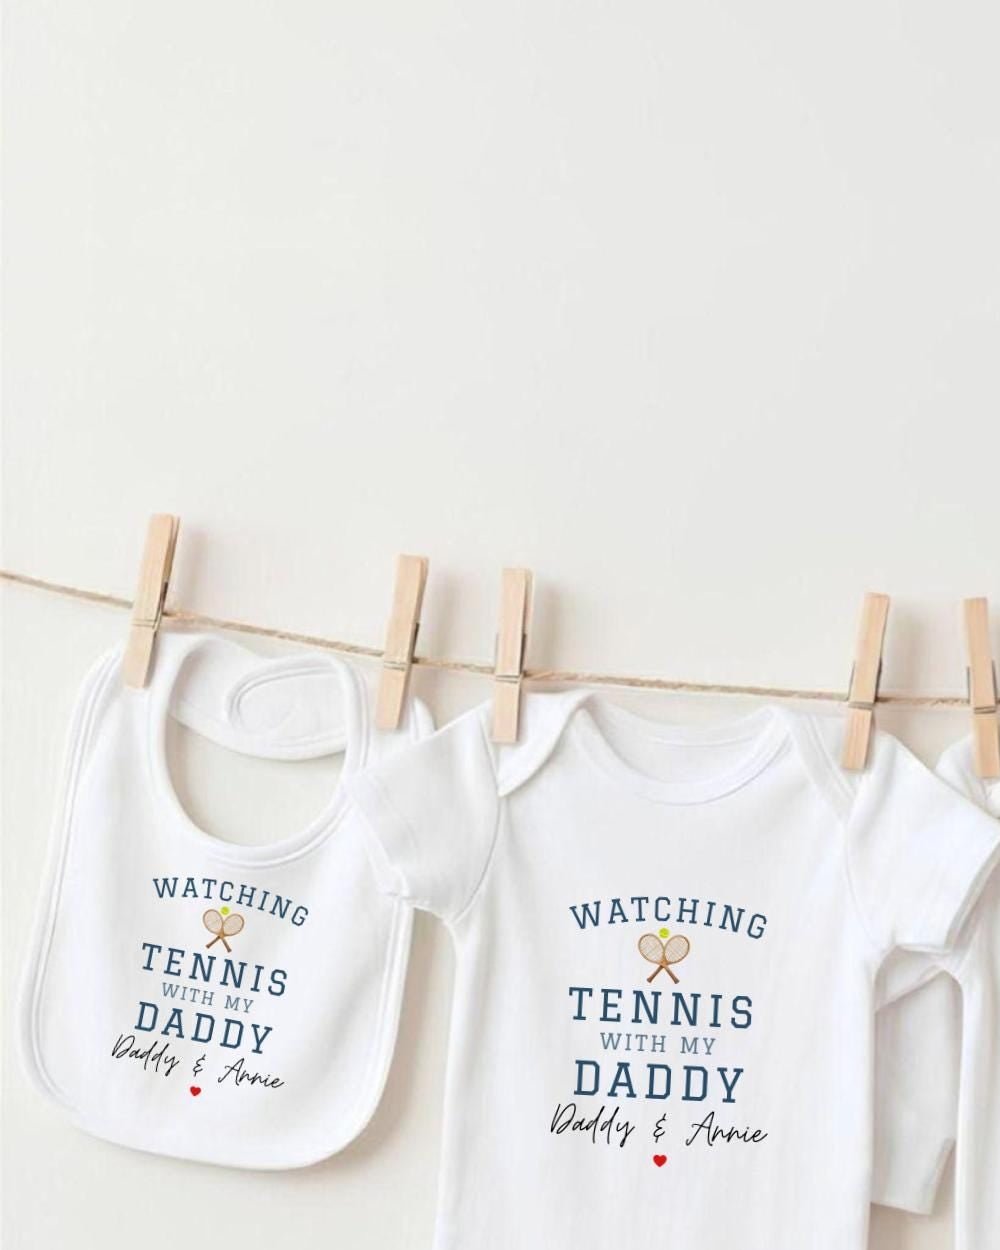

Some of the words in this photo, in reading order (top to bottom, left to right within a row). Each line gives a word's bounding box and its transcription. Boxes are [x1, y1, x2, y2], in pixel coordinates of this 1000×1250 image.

[152, 876, 309, 927] WATCHING
[568, 896, 768, 940] WATCHING
[141, 942, 288, 997] TENNIS
[162, 981, 215, 1006] WITH
[223, 994, 254, 1014] MY
[568, 986, 753, 1030] TENNIS
[133, 1000, 273, 1055] DADDY
[599, 1032, 667, 1053] WITH
[679, 1036, 716, 1056] MY
[111, 1033, 180, 1078] Daddy
[192, 1053, 207, 1079] &
[216, 1055, 286, 1090] Annie
[573, 1059, 745, 1104] DADDY
[550, 1102, 637, 1149] Daddy
[651, 1112, 667, 1144] &
[685, 1110, 769, 1148] Annie
